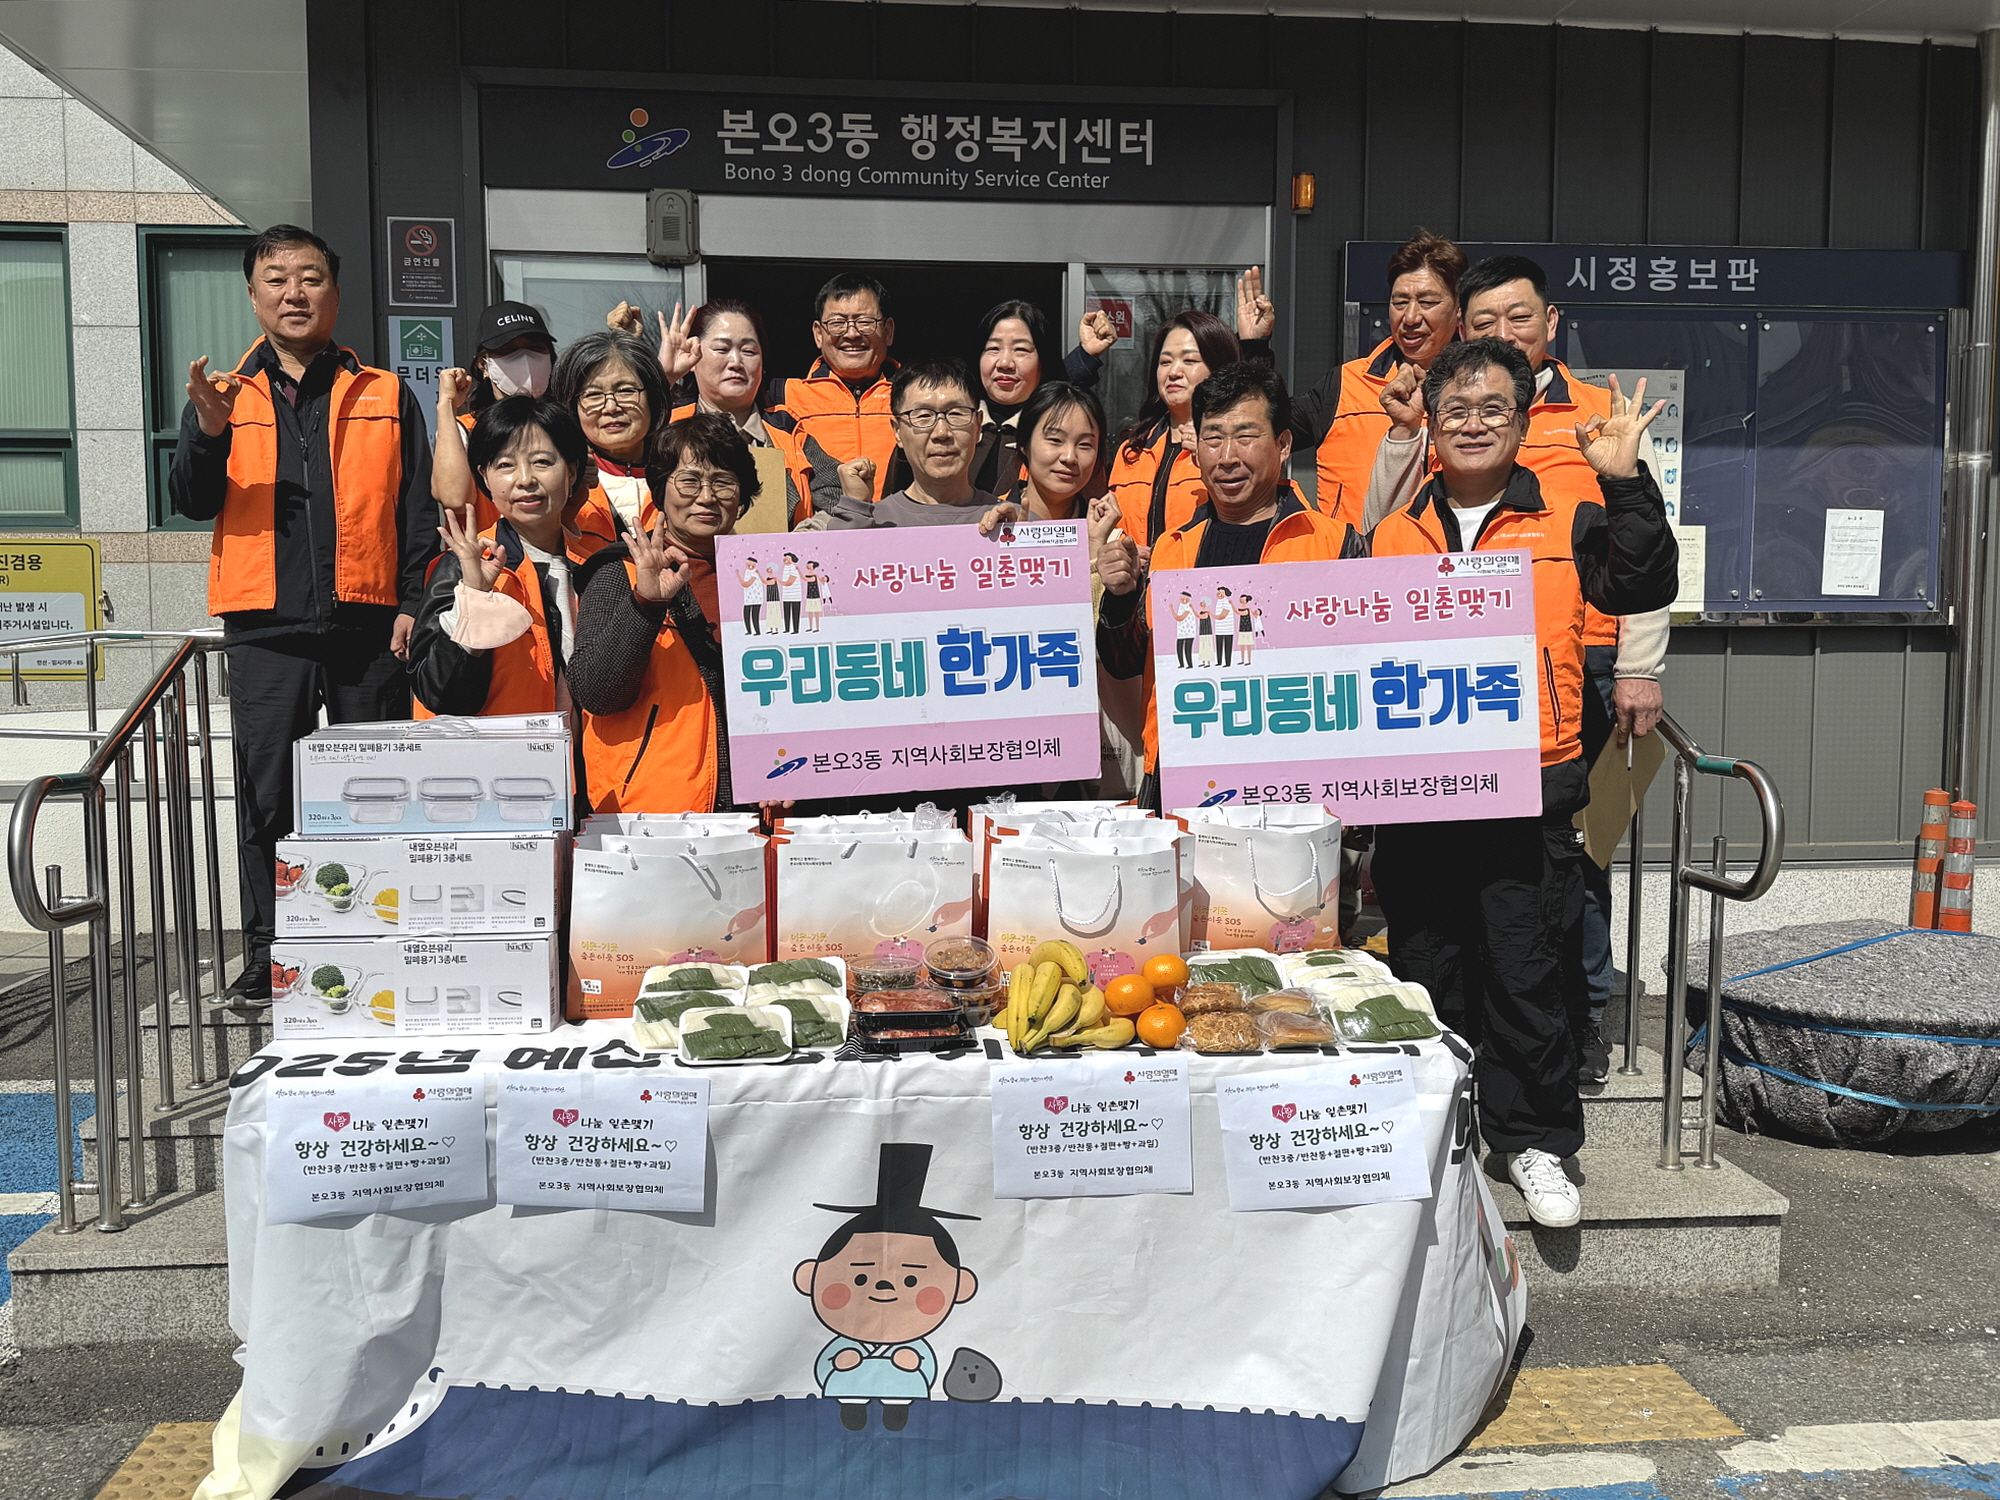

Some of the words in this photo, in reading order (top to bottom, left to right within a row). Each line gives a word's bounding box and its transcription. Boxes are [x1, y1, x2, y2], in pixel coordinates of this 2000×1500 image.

[717, 109, 879, 160] 본오3동
[900, 113, 1153, 166] 행정복지센터
[725, 163, 776, 181] Bono
[782, 164, 793, 182] 3
[801, 164, 851, 188] dong
[858, 166, 969, 190] Community
[975, 169, 1040, 188] Service
[1046, 171, 1110, 189] Center
[1566, 256, 1760, 292] 시정홍보판
[497, 313, 535, 327] CELINE
[397, 365, 448, 385] 무더
[853, 558, 957, 593] 사랑나눔
[970, 554, 1071, 589] 일촌맺기
[0, 602, 12, 613] 난
[15, 602, 35, 613] 발생
[38, 602, 48, 613] 시
[1286, 591, 1391, 627] 사랑나눔
[1406, 586, 1512, 621] 일촌맺기
[0, 619, 74, 630] 주거시설입니다.
[741, 640, 927, 707] 우리동네
[936, 627, 1082, 697] 한가족
[1173, 672, 1360, 739] 우리동네
[1370, 660, 1521, 730] 한가족
[393, 743, 422, 752] 3종세트
[811, 749, 883, 774] 본오3동
[891, 737, 1061, 768] 지역사회보장협의체
[1241, 782, 1313, 805] 본오3동
[1322, 773, 1498, 802] 지역사회보장협의체
[443, 853, 472, 863] 3종세트
[1225, 917, 1242, 926] SOS
[825, 943, 843, 951] SOS
[438, 955, 468, 964] 3종세트
[616, 954, 634, 962] SOS
[1048, 1099, 1065, 1110] 사랑
[1071, 1103, 1092, 1114] 나눔
[1097, 1099, 1139, 1112] 일촌맺기
[1276, 1107, 1294, 1119] 사랑
[1300, 1110, 1321, 1122] 나눔
[1325, 1102, 1368, 1117] 일촌맺기
[327, 1114, 346, 1128] 사랑
[353, 1119, 376, 1131] 나눔
[382, 1118, 428, 1131] 일촌맺기
[557, 1112, 575, 1123] 사랑
[581, 1118, 603, 1129] 나눔
[608, 1118, 654, 1130] 일촌맺기
[1018, 1123, 1050, 1141] 항상
[295, 1140, 330, 1159] 항상
[524, 1133, 558, 1151] 항상
[1249, 1132, 1281, 1151] 항상
[1033, 1169, 1065, 1180] 본오3동
[1070, 1165, 1153, 1178] 지역사회보장협의체
[1268, 1179, 1300, 1190] 본오3동
[1305, 1171, 1391, 1188] 지역사회보장협의체
[311, 1191, 346, 1202] 본오3동
[352, 1180, 445, 1198] 지역사회보장협의체
[538, 1181, 571, 1190] 본오3동
[577, 1182, 664, 1194] 지역사회보장협의체
